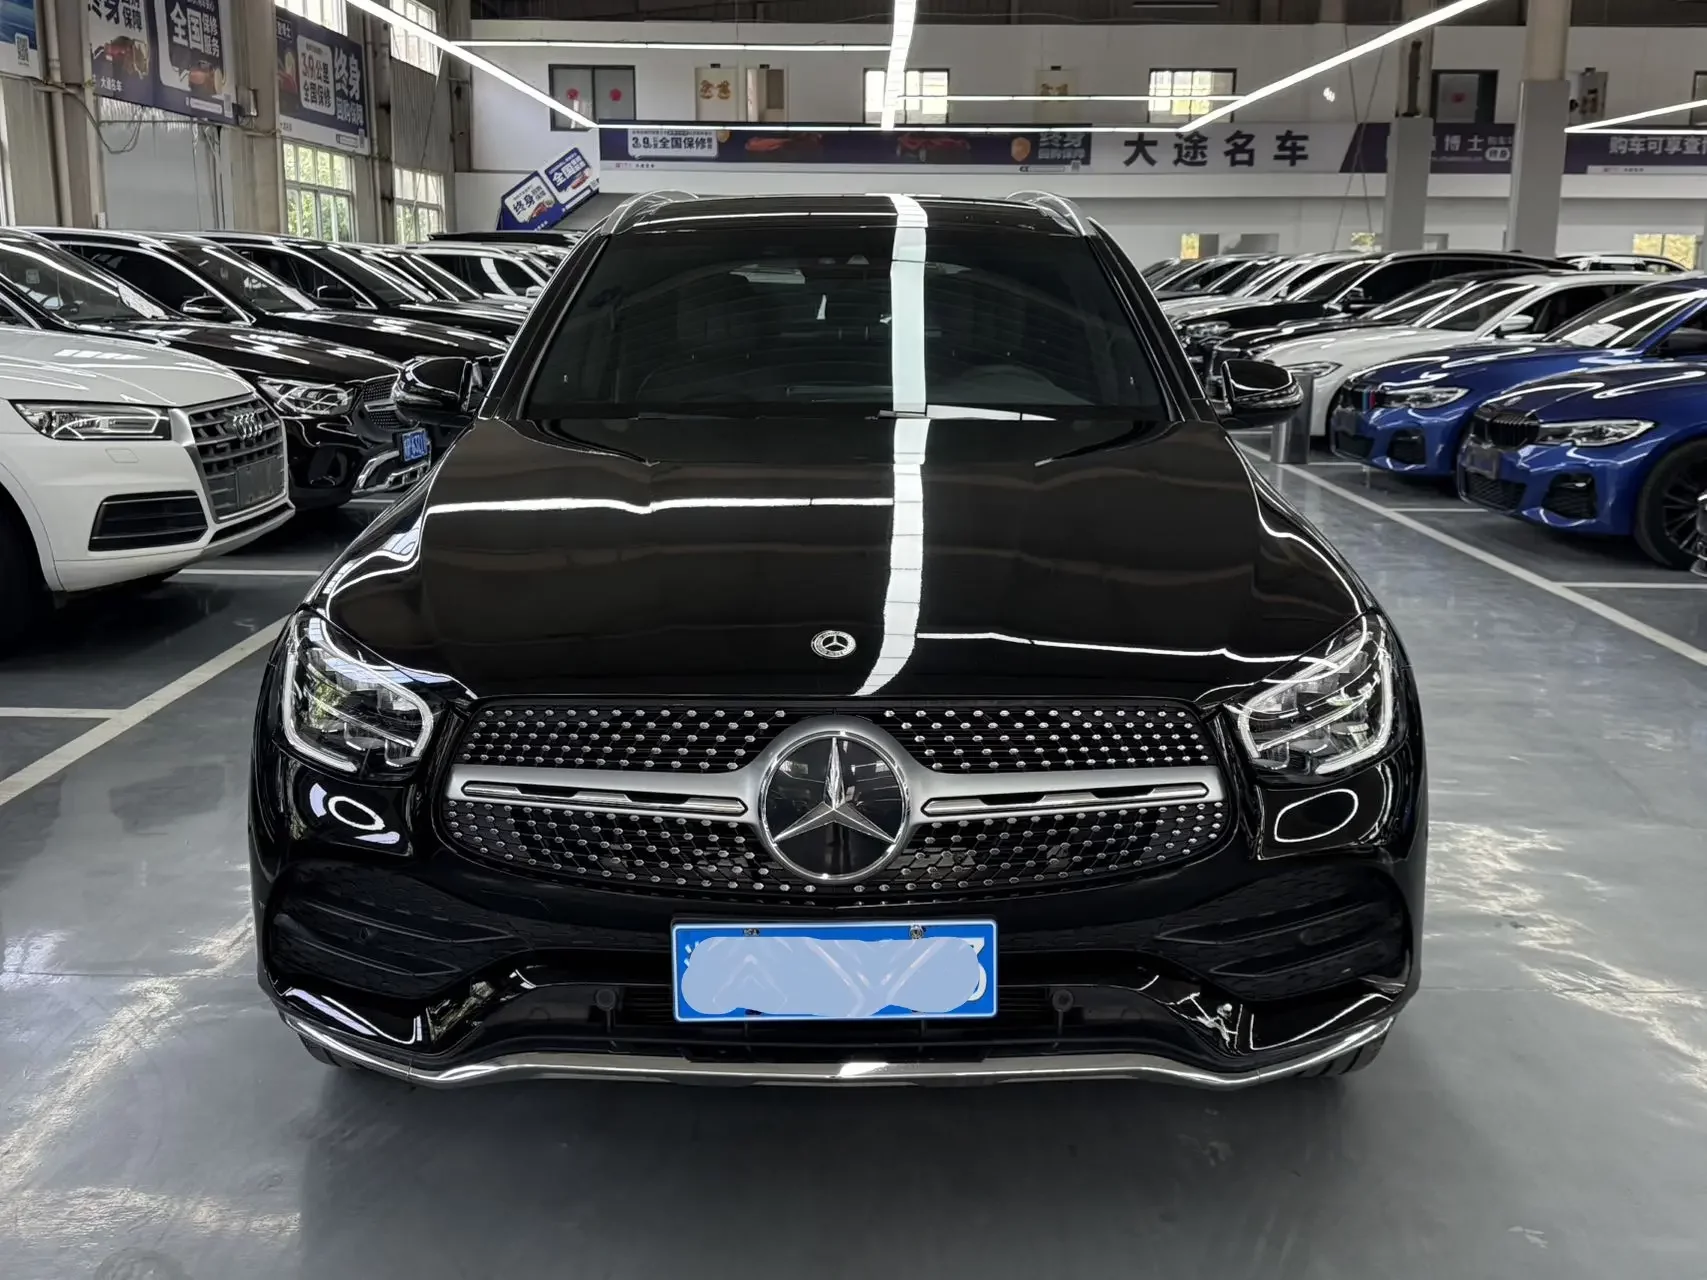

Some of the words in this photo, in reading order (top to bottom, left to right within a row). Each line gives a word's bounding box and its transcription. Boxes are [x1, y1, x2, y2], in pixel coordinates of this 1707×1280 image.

[170, 2, 205, 53] 全国
[1123, 130, 1309, 167] 大途名车
[1433, 134, 1484, 151] 博士
